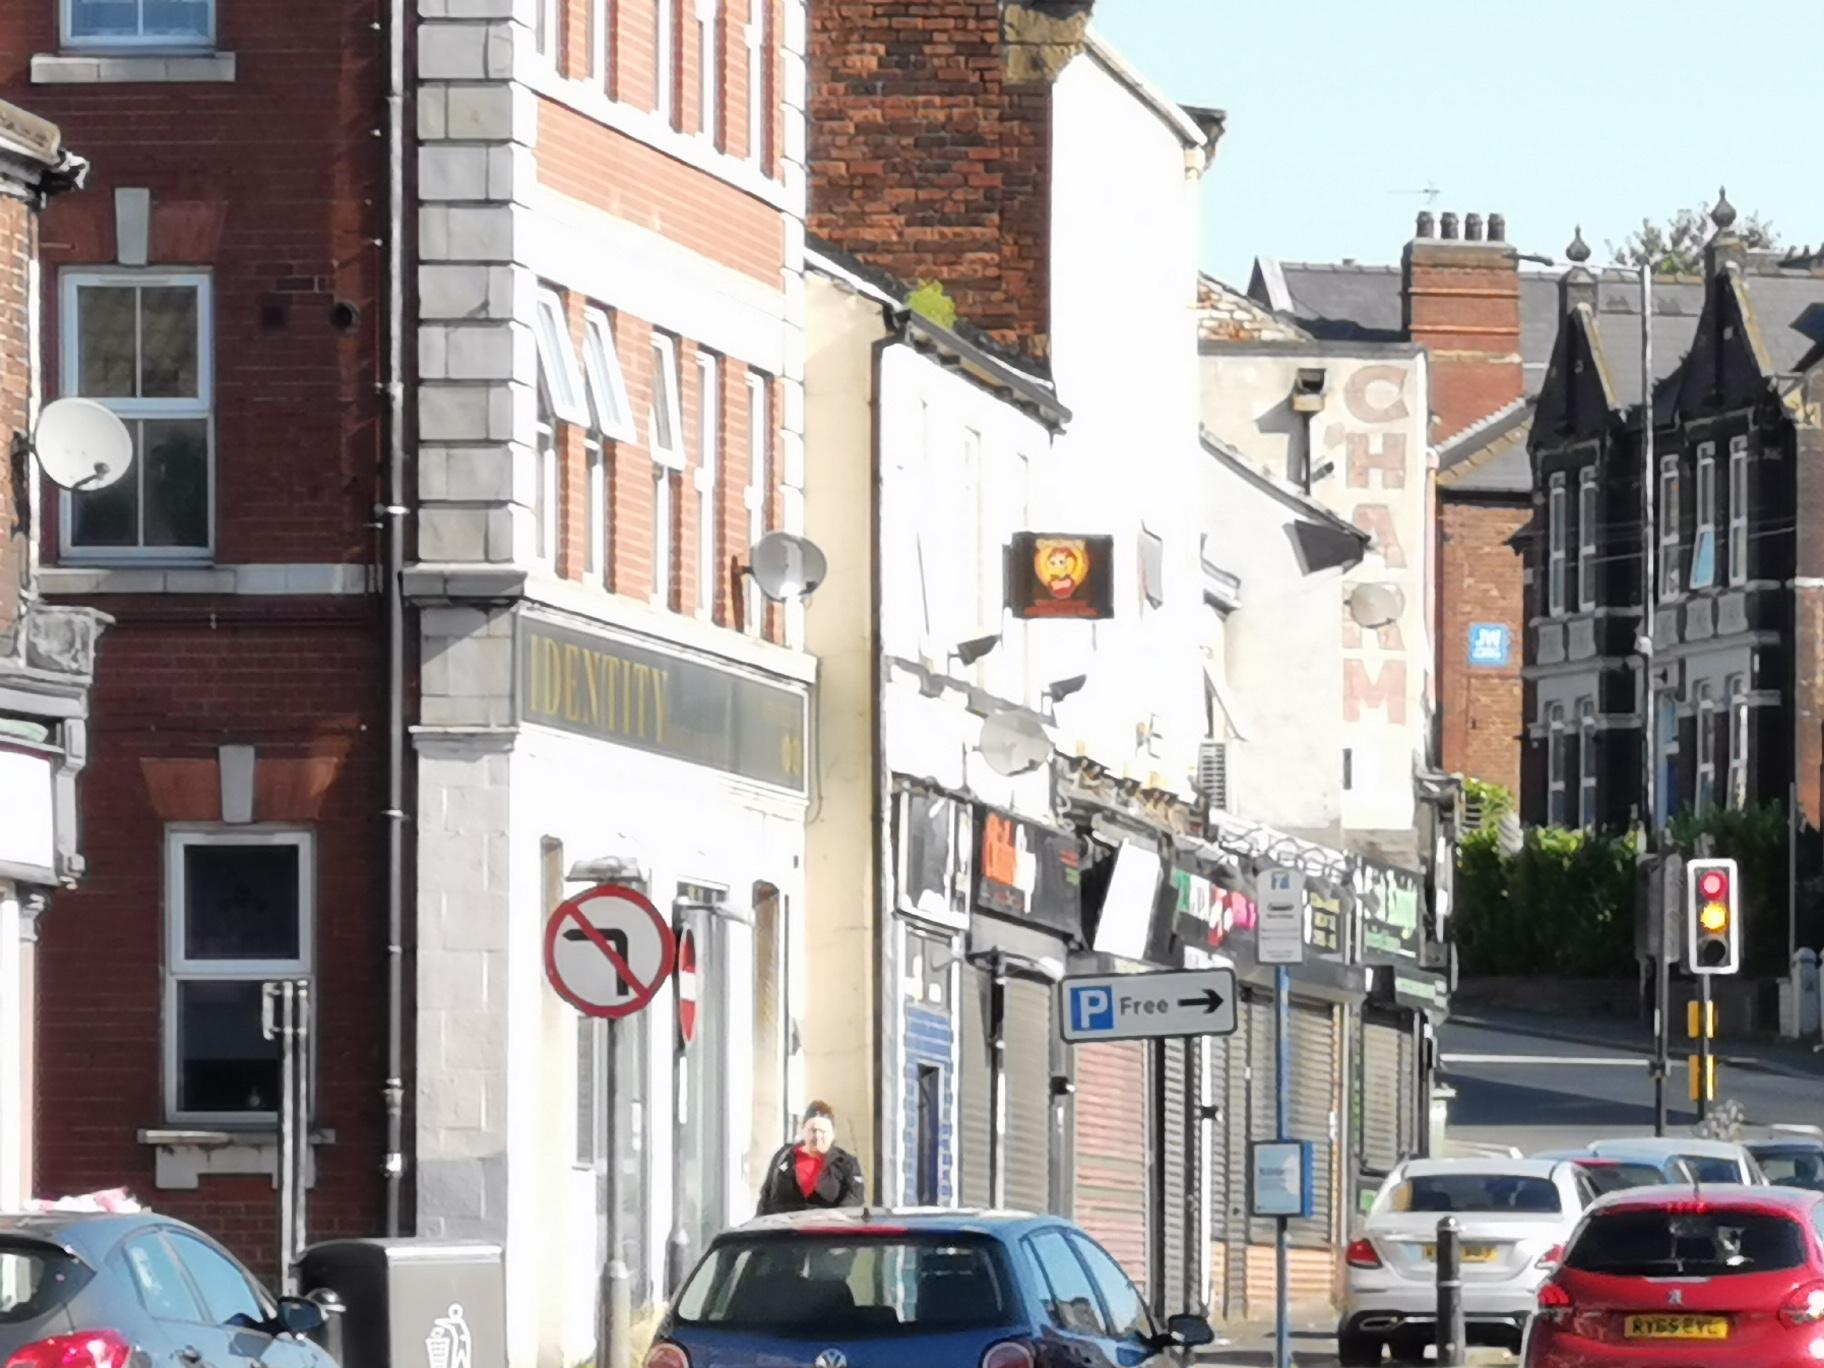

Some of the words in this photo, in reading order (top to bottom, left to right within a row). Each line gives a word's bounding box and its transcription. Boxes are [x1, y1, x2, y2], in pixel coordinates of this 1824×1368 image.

[530, 632, 669, 744] IDENTITY
[1079, 990, 1109, 1029] P
[1120, 996, 1169, 1016] Free
